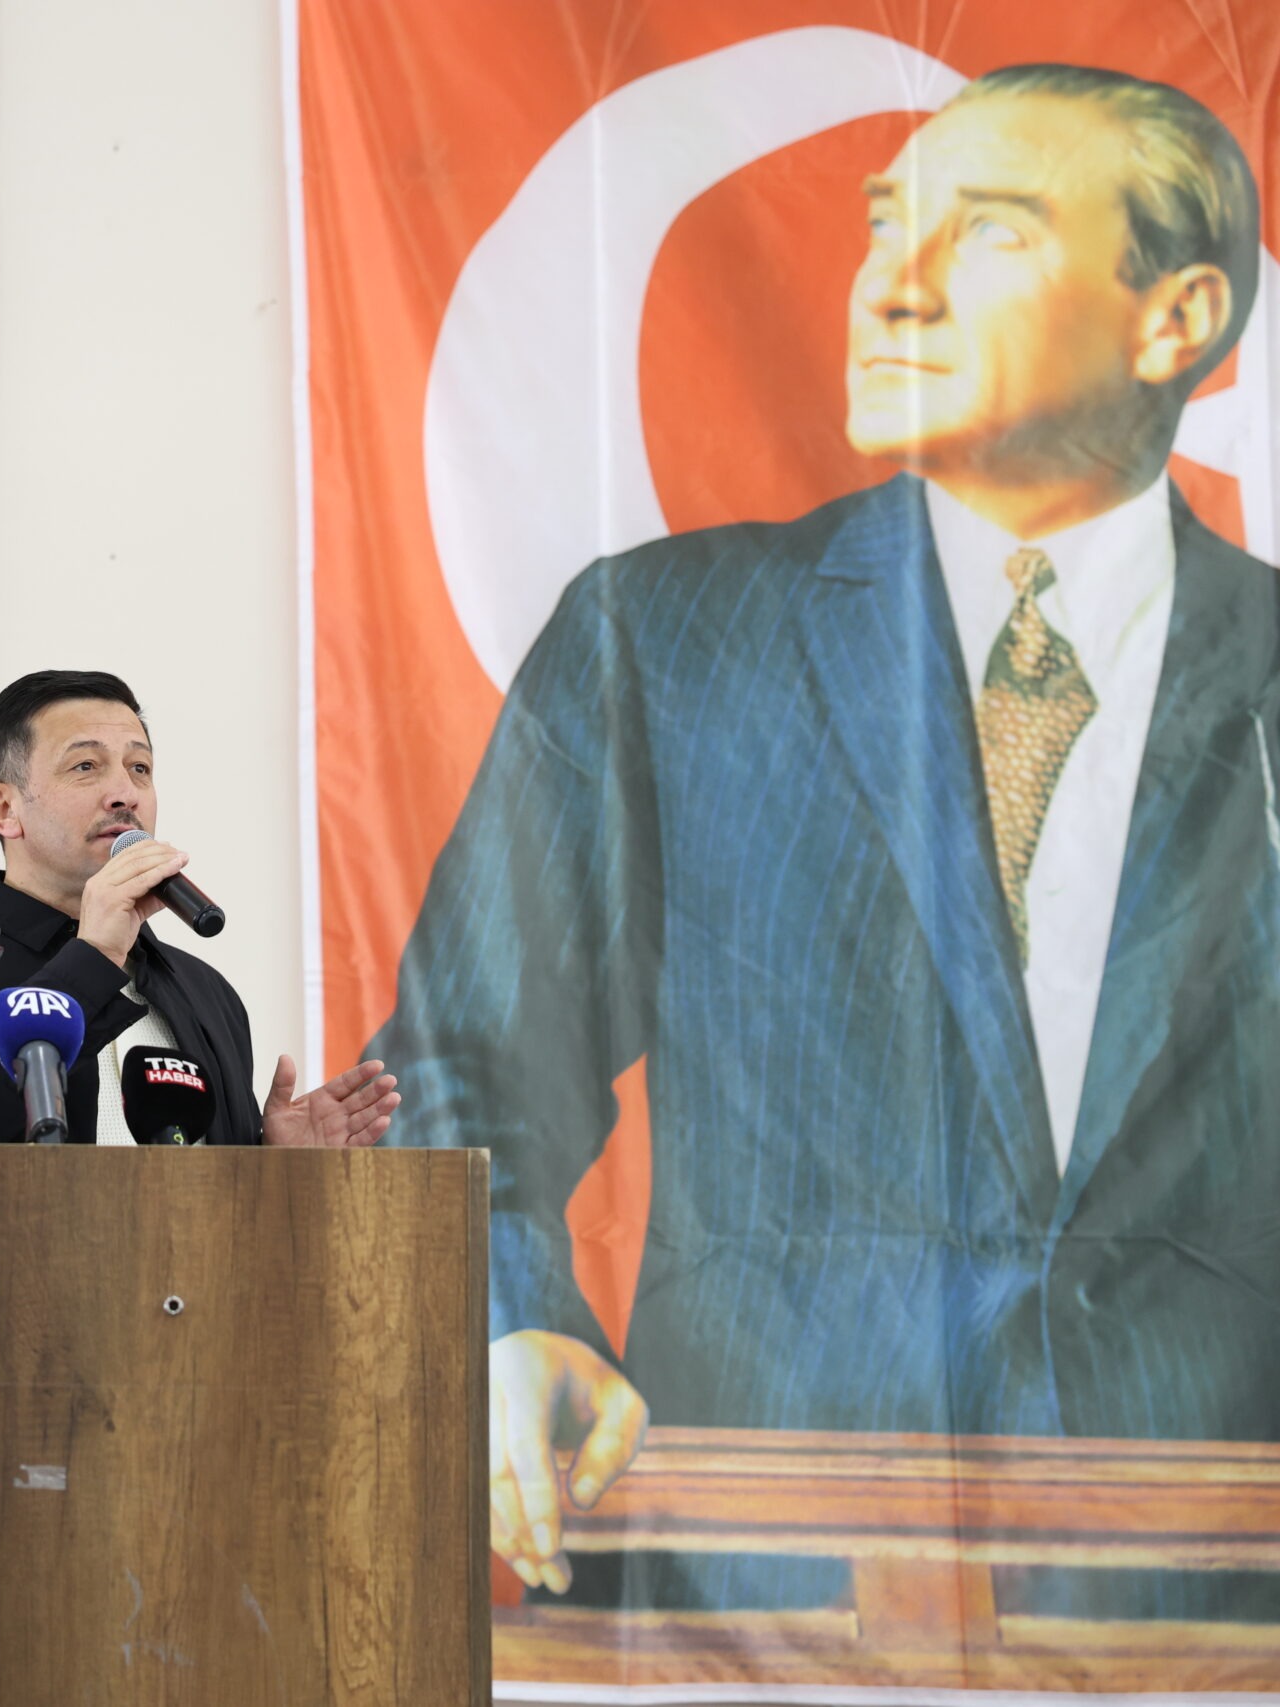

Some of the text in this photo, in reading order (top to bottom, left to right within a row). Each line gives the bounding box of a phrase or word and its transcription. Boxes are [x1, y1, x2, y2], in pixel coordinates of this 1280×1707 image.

[7, 988, 72, 1019] AA
[144, 1057, 199, 1076] TRT
[149, 1070, 204, 1090] HABER
